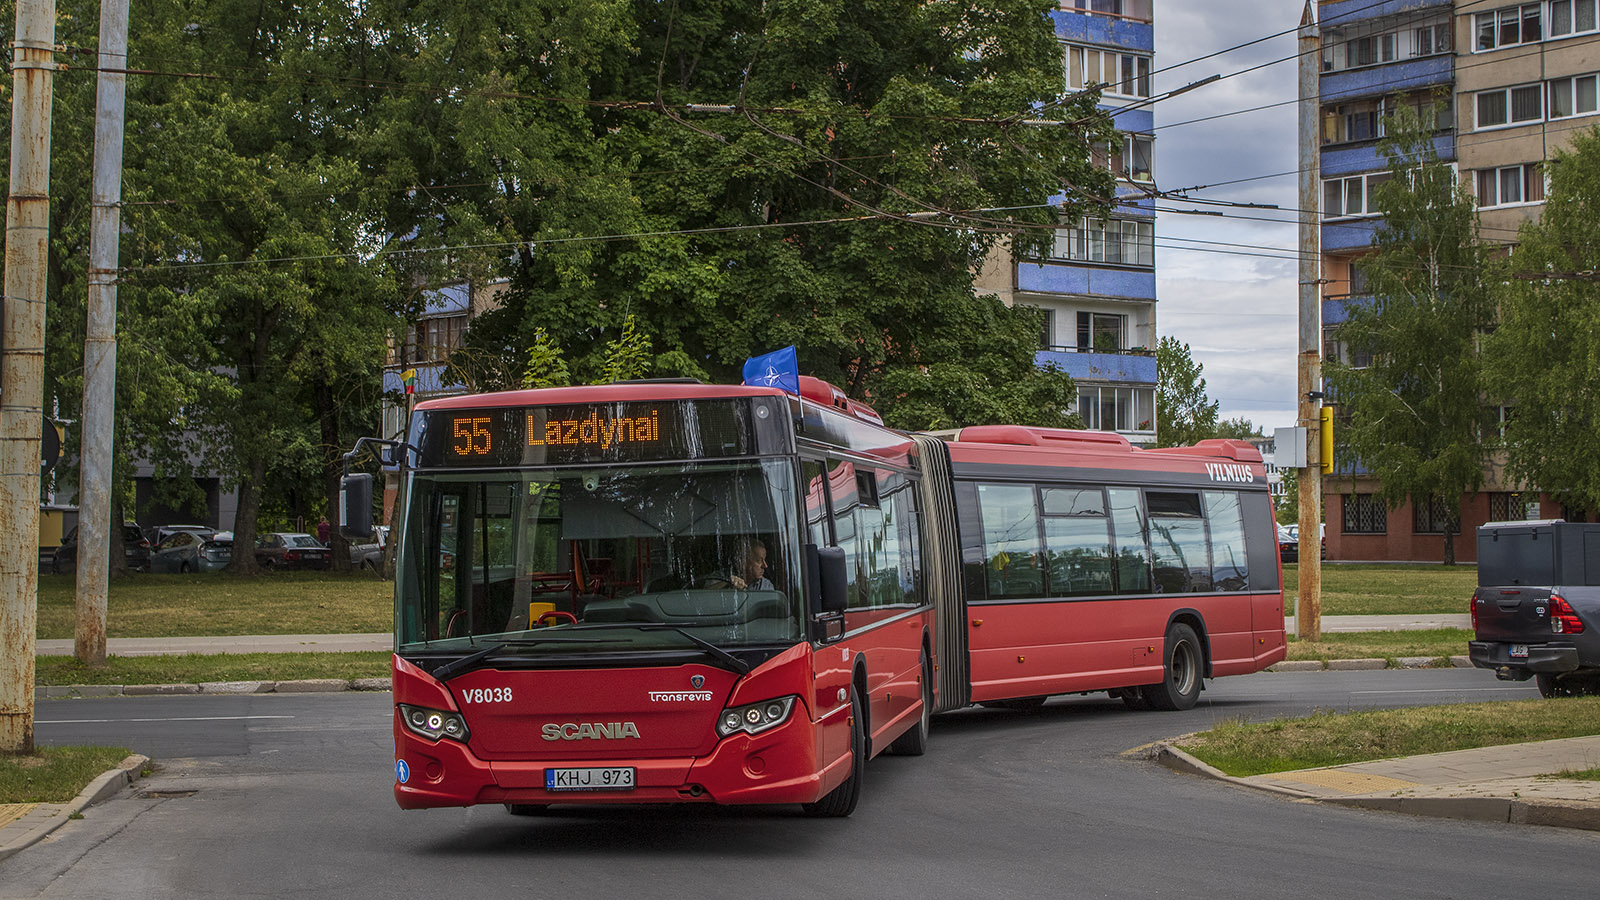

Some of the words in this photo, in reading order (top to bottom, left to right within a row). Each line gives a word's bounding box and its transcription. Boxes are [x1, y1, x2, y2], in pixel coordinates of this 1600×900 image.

[453, 417, 492, 455] 55
[527, 409, 659, 450] Lazdynai
[1204, 462, 1254, 483] VILNIUS
[462, 687, 513, 704] V8038
[541, 722, 641, 741] SCANIA
[556, 770, 592, 786] KHJ
[602, 769, 632, 785] 973
